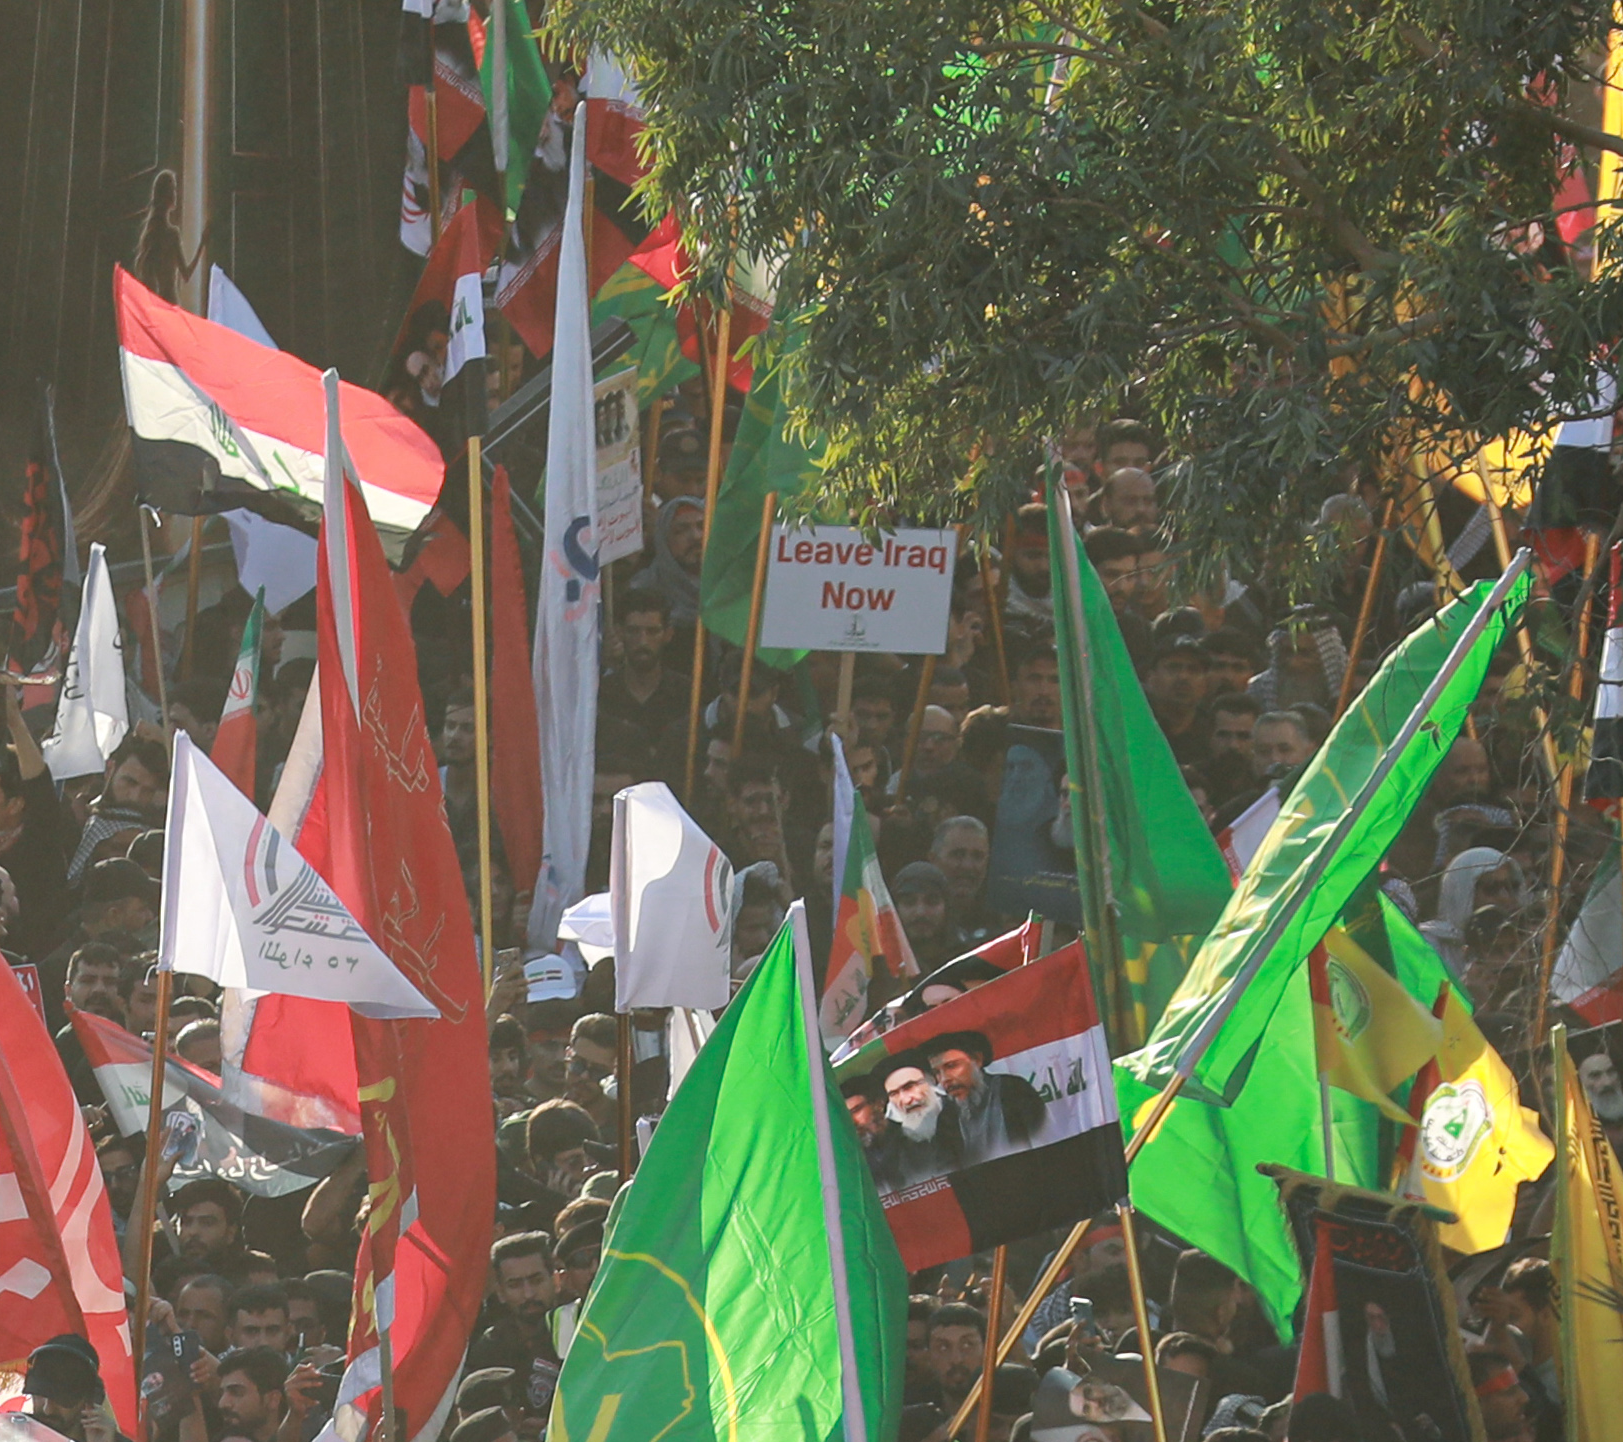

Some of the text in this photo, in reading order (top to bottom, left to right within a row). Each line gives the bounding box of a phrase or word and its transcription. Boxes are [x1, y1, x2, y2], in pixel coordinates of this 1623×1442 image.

[777, 535, 947, 575] Leave Iraq
[821, 581, 896, 611] Now
